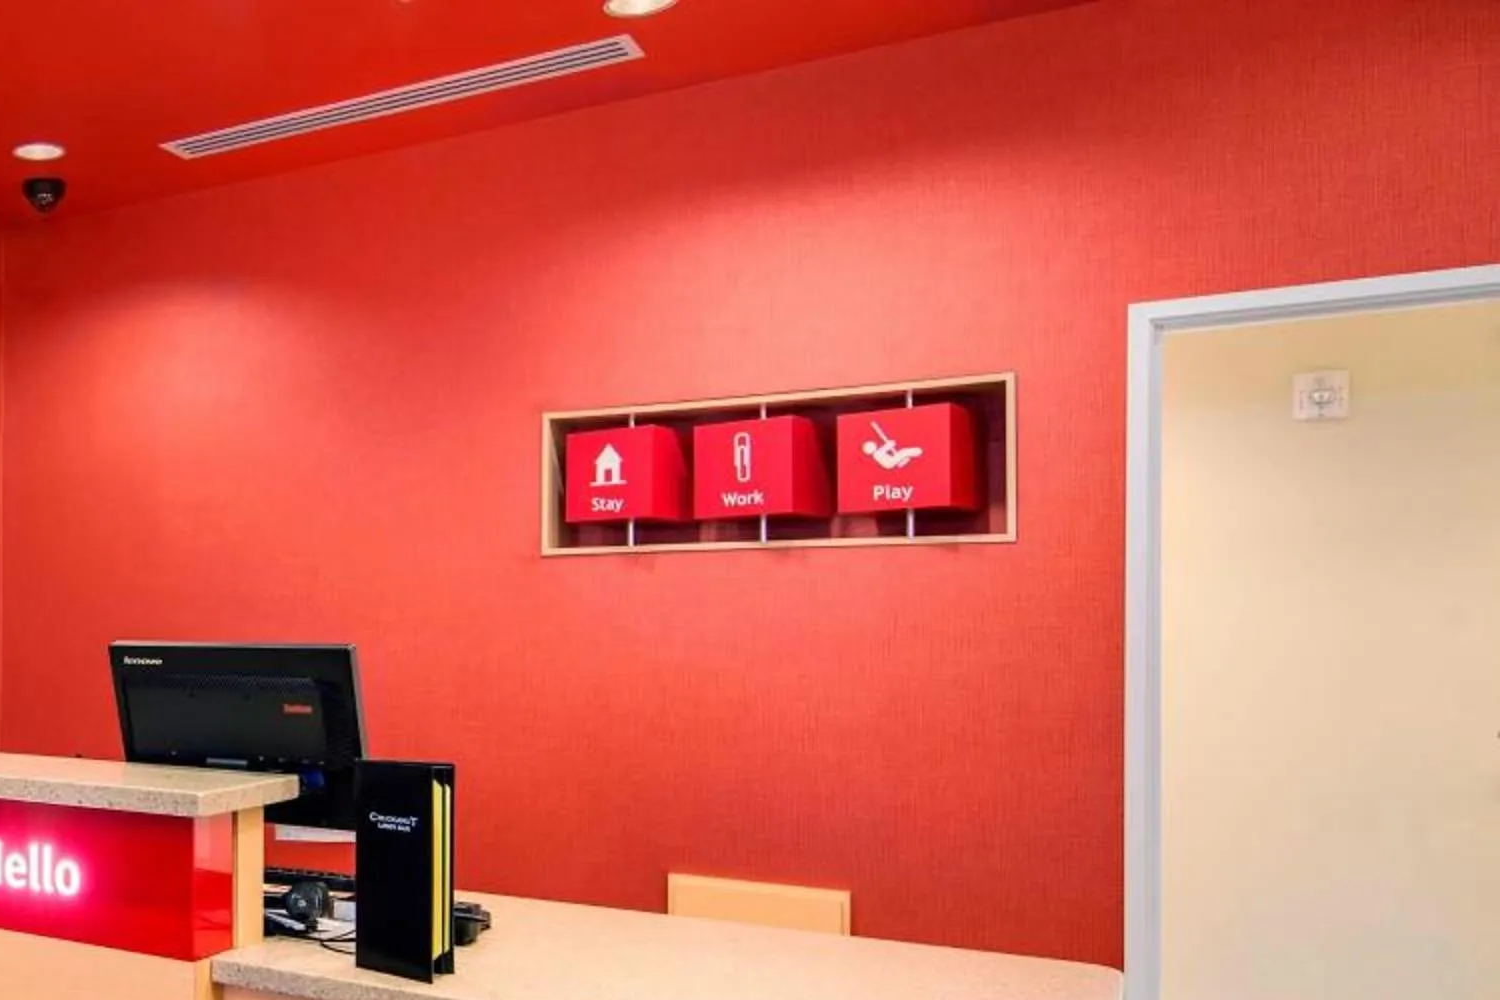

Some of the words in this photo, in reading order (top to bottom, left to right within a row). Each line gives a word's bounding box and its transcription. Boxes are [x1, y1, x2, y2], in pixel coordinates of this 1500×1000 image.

[721, 490, 764, 507] Work
[873, 484, 914, 502] Play
[591, 497, 624, 512] Stay
